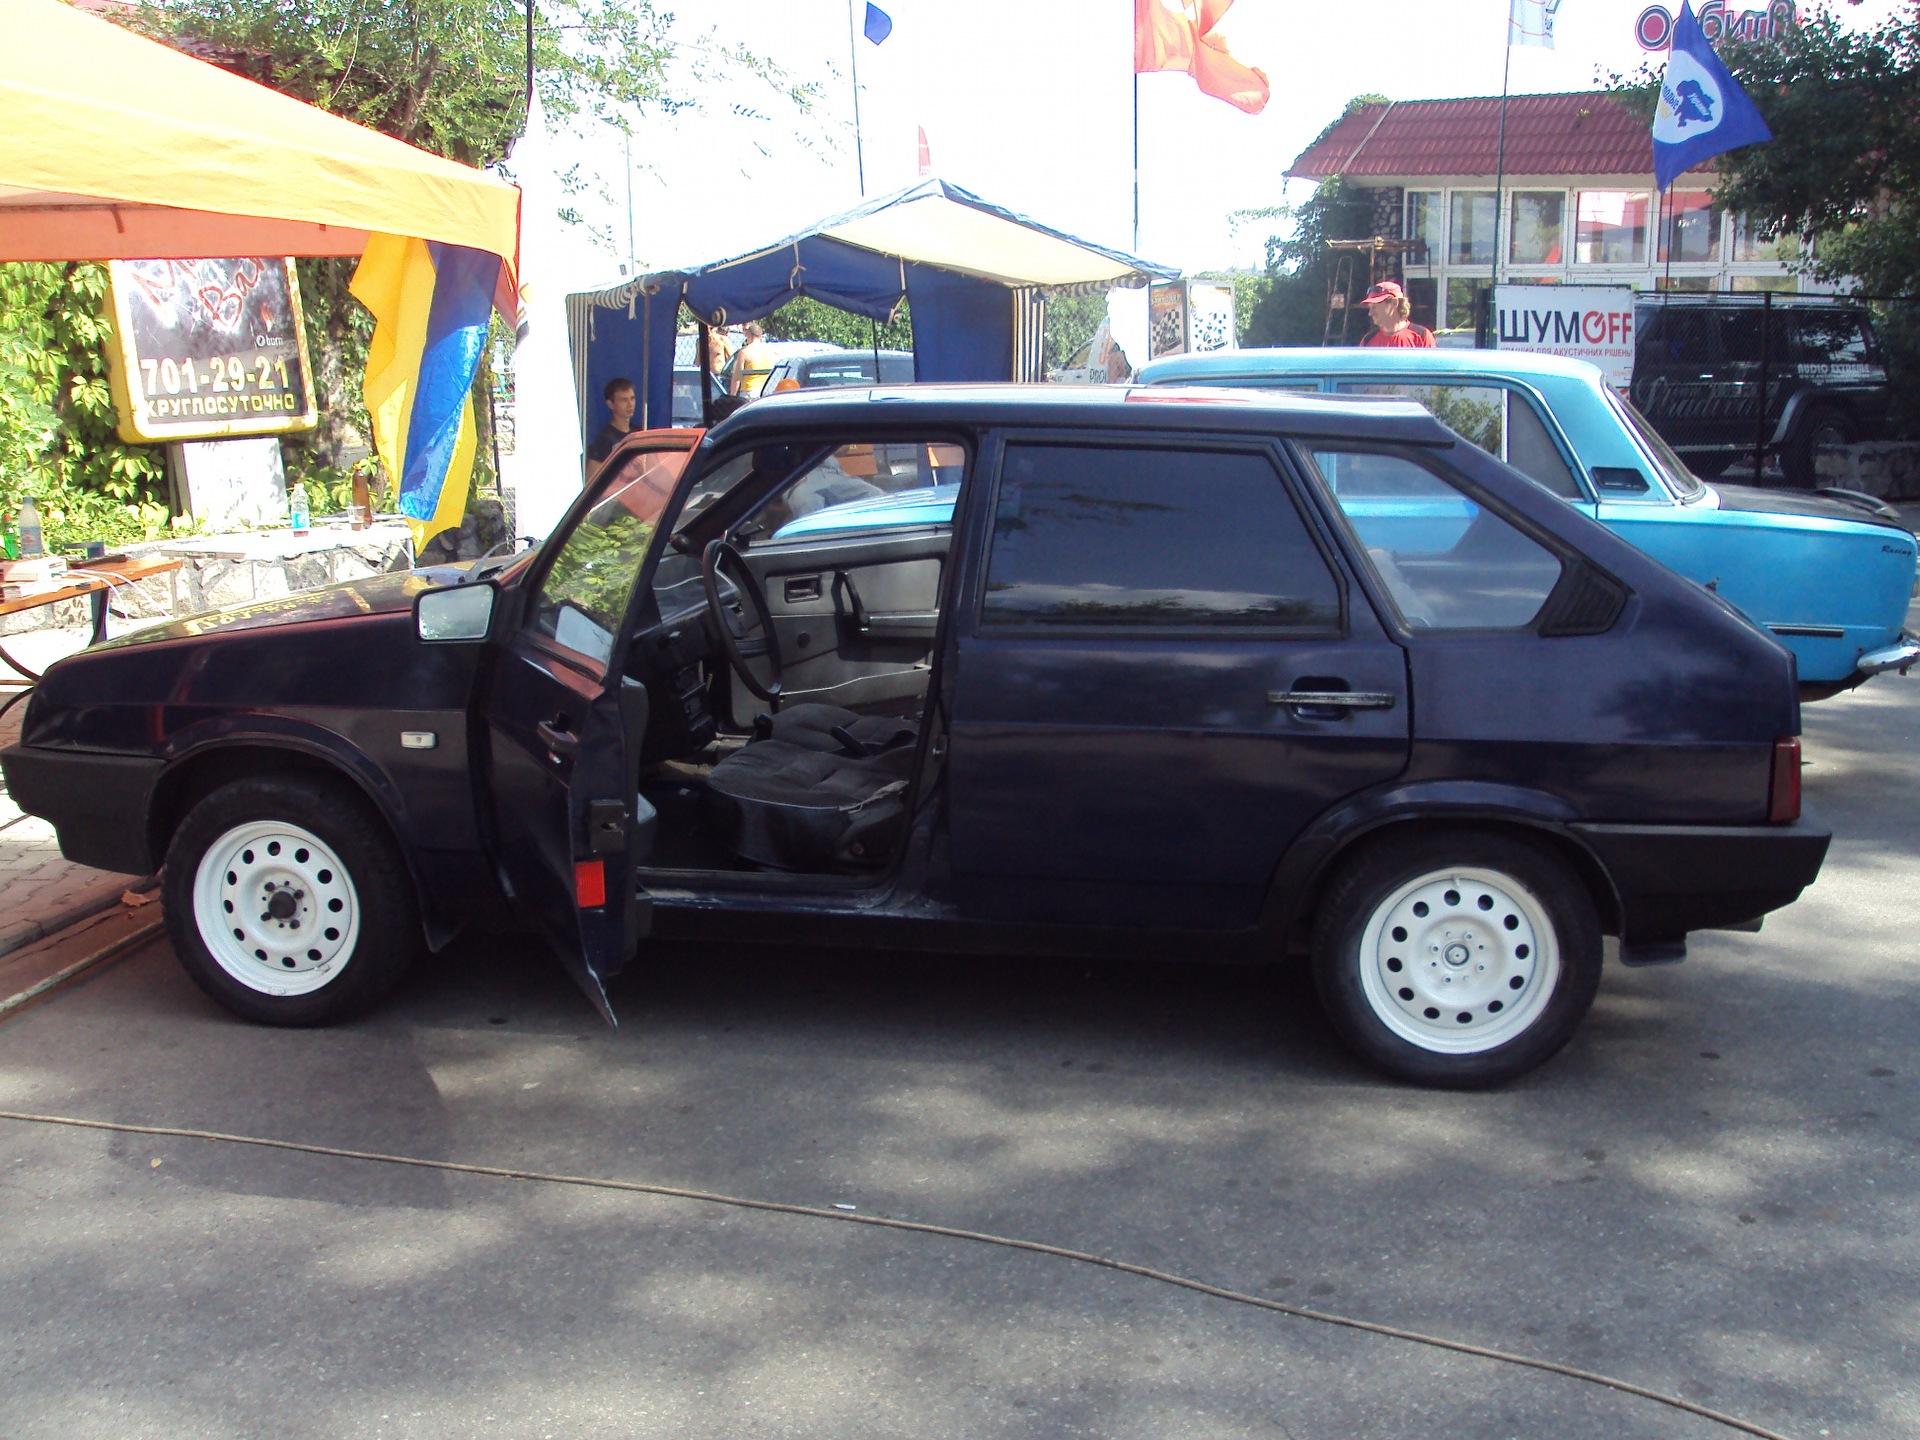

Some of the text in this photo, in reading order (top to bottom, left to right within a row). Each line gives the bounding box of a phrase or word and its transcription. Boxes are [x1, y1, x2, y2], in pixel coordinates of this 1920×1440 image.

[140, 355, 290, 396] 701-29-21
[1797, 363, 1829, 374] AUDIO
[146, 393, 296, 418] КРУГЛОСУТОЧНО
[1881, 545, 1912, 558] Racing
